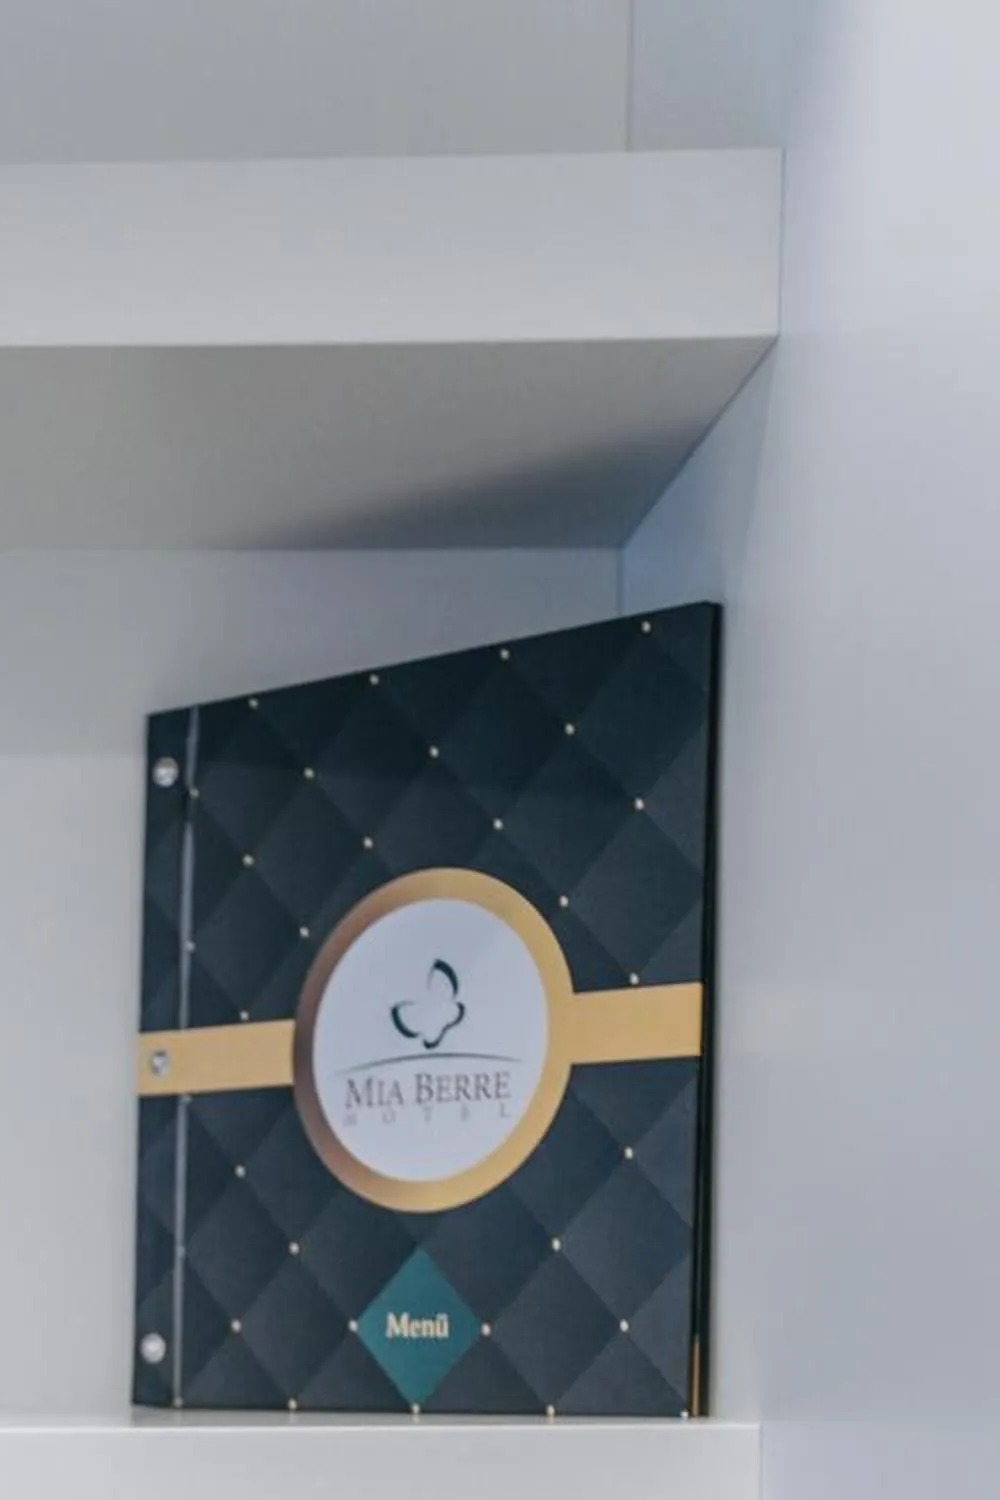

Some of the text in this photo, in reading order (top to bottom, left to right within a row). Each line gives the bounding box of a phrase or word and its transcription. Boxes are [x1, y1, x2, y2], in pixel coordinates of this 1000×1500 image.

[345, 1070, 512, 1109] MIA BERRE
[385, 1311, 450, 1340] Menü
